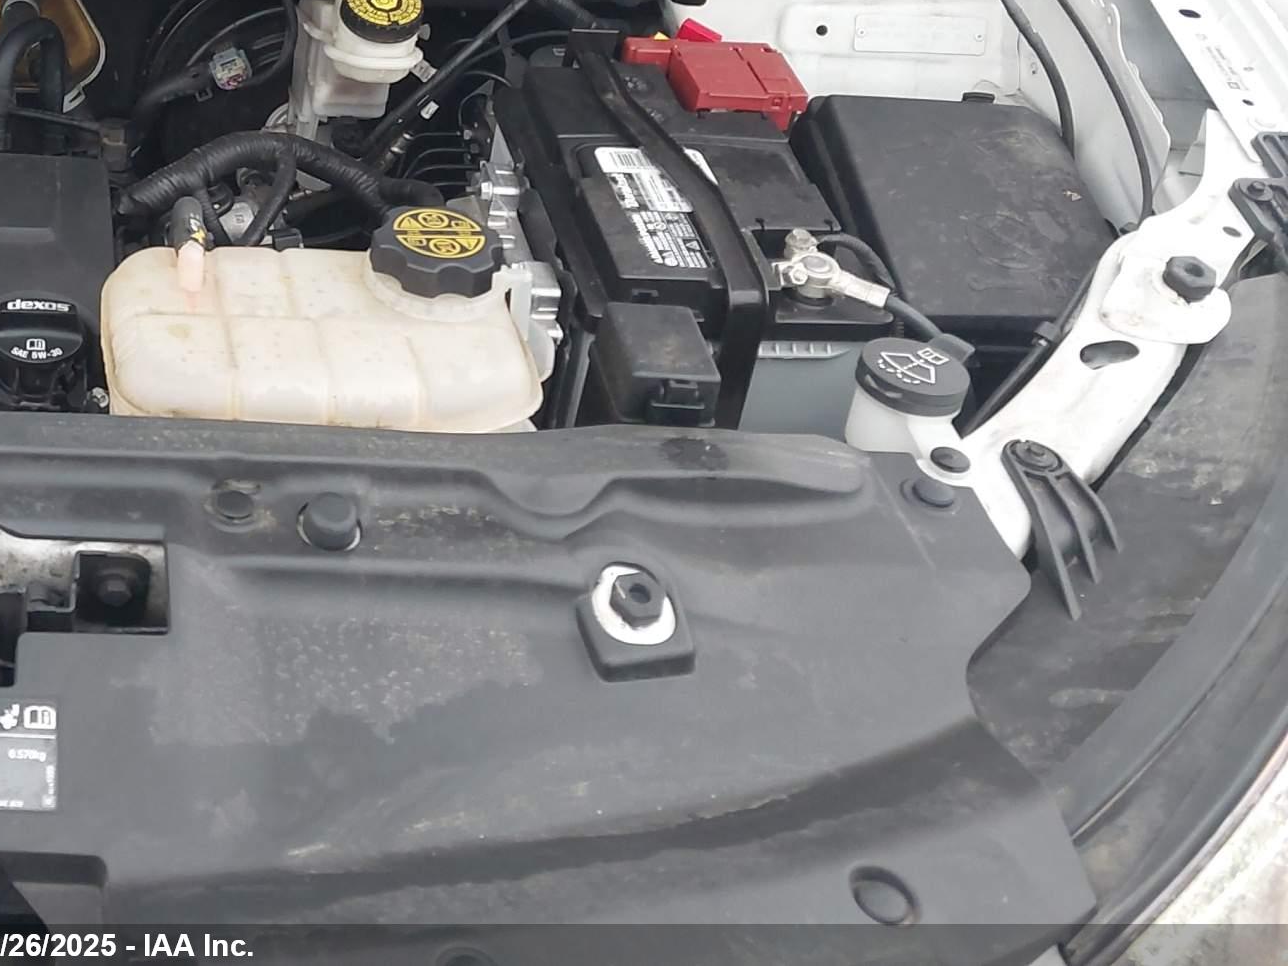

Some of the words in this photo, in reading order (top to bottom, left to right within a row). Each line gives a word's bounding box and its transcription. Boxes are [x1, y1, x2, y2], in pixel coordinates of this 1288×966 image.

[7, 299, 71, 312] dexos
[11, 346, 29, 359] SAE
[31, 347, 63, 359] 5W-30
